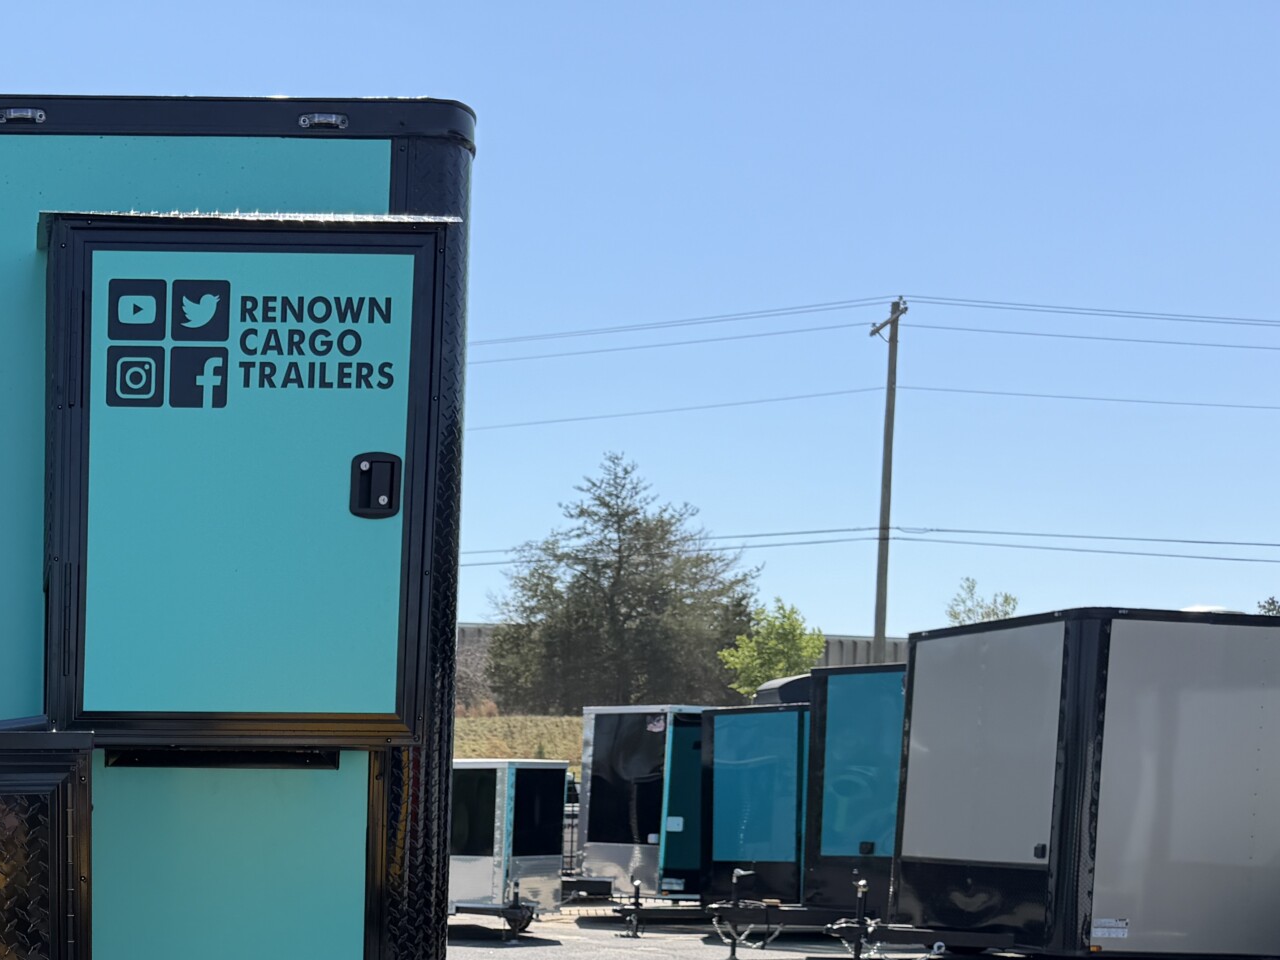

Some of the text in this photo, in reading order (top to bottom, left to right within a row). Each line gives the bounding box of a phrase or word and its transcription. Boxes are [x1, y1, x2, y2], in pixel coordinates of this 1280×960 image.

[239, 295, 393, 324] RENOWN
[238, 328, 363, 357] CARGO
[238, 361, 395, 390] TRAILERS
